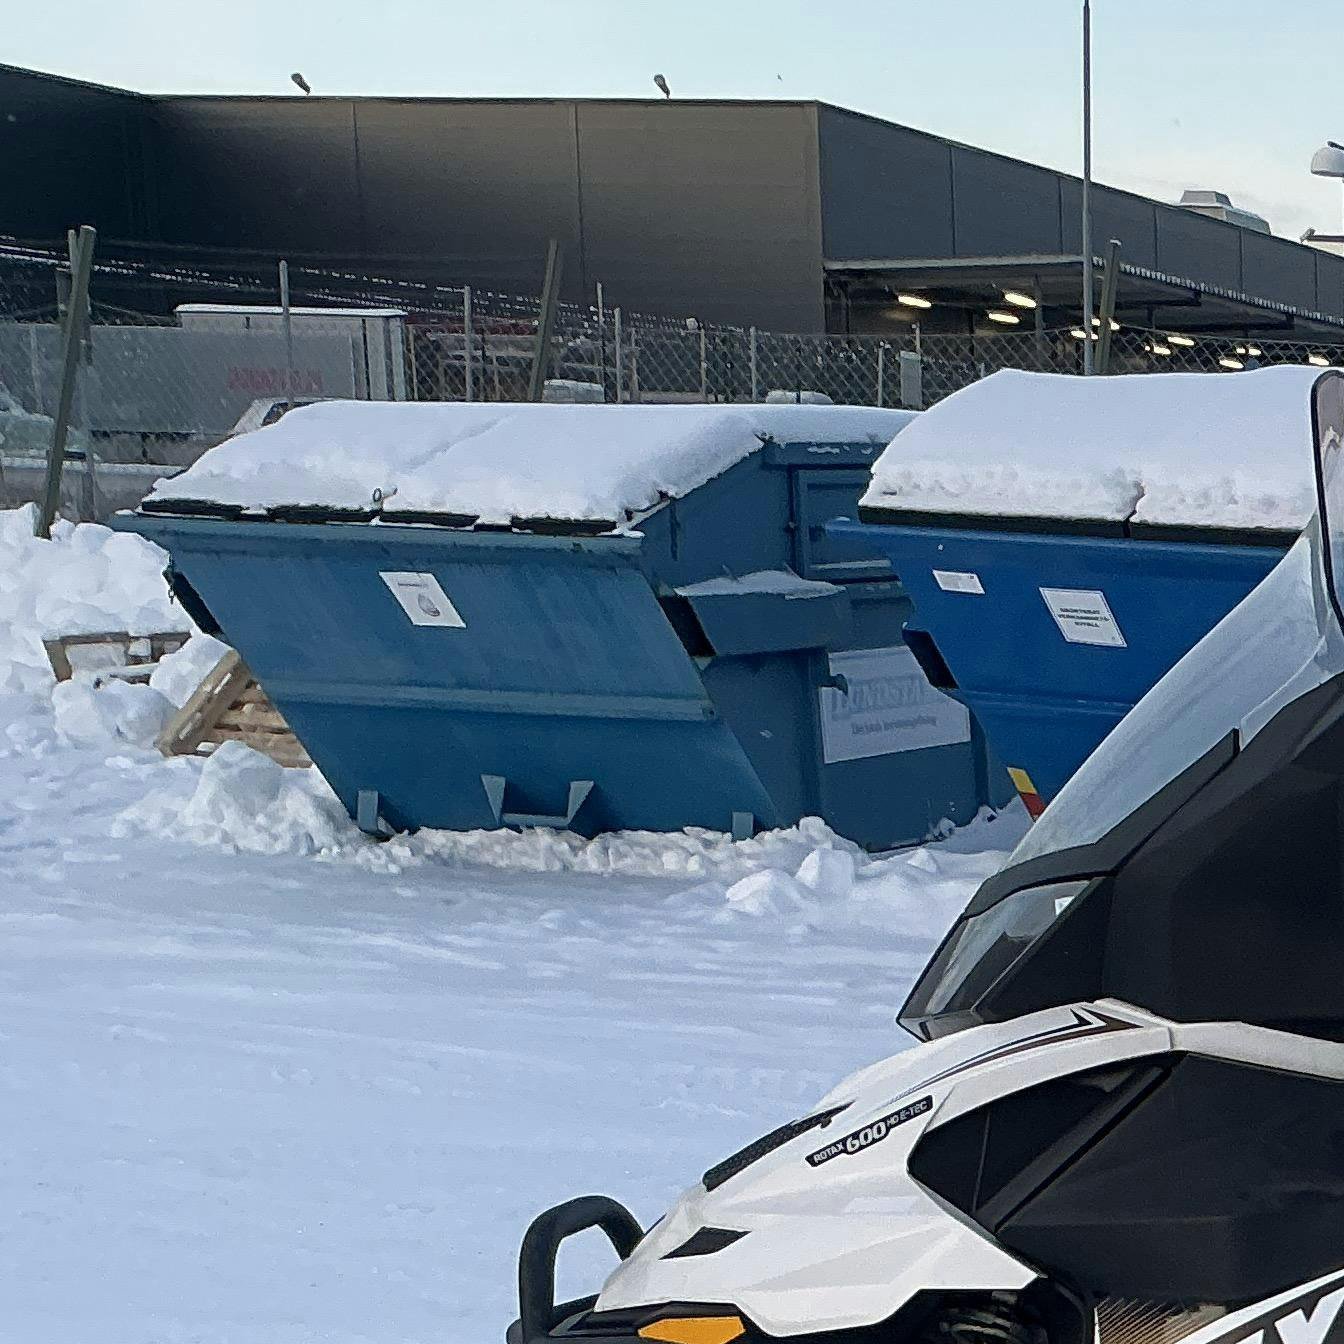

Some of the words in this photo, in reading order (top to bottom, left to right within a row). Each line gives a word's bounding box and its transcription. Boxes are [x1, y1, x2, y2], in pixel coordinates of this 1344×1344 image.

[813, 1141, 845, 1163] ROTAX
[846, 1121, 887, 1153] 600
[900, 1101, 928, 1121] E-TEC
